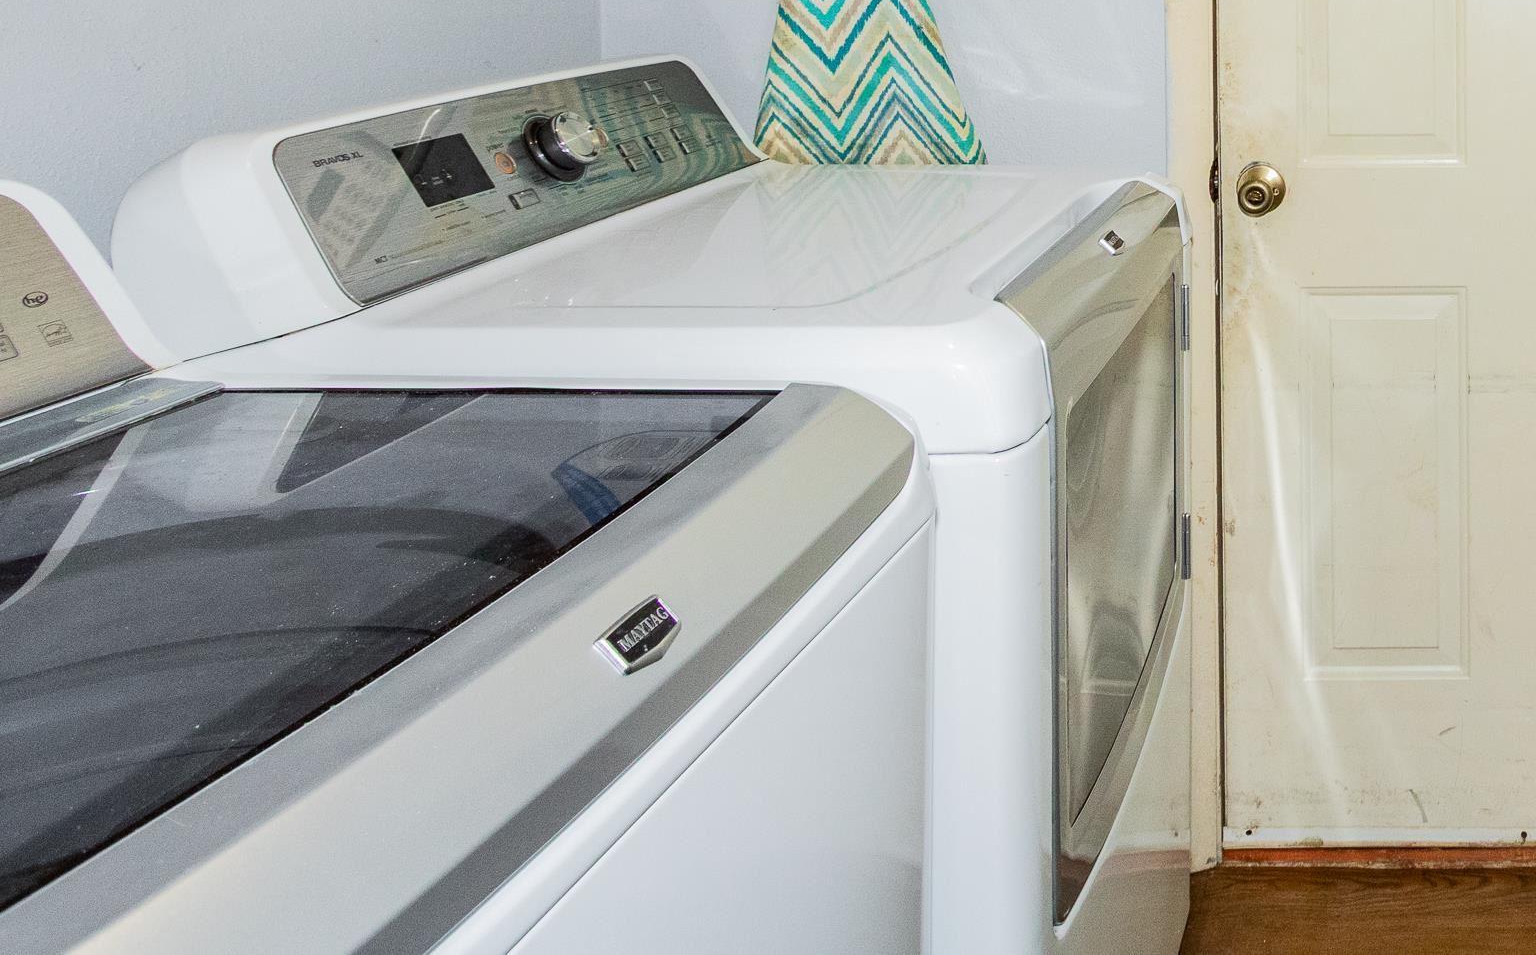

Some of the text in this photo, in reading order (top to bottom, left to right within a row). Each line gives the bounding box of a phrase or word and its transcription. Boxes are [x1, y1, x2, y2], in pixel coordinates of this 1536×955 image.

[312, 150, 364, 168] BRAVOS XL
[616, 606, 669, 653] MAYTAG
